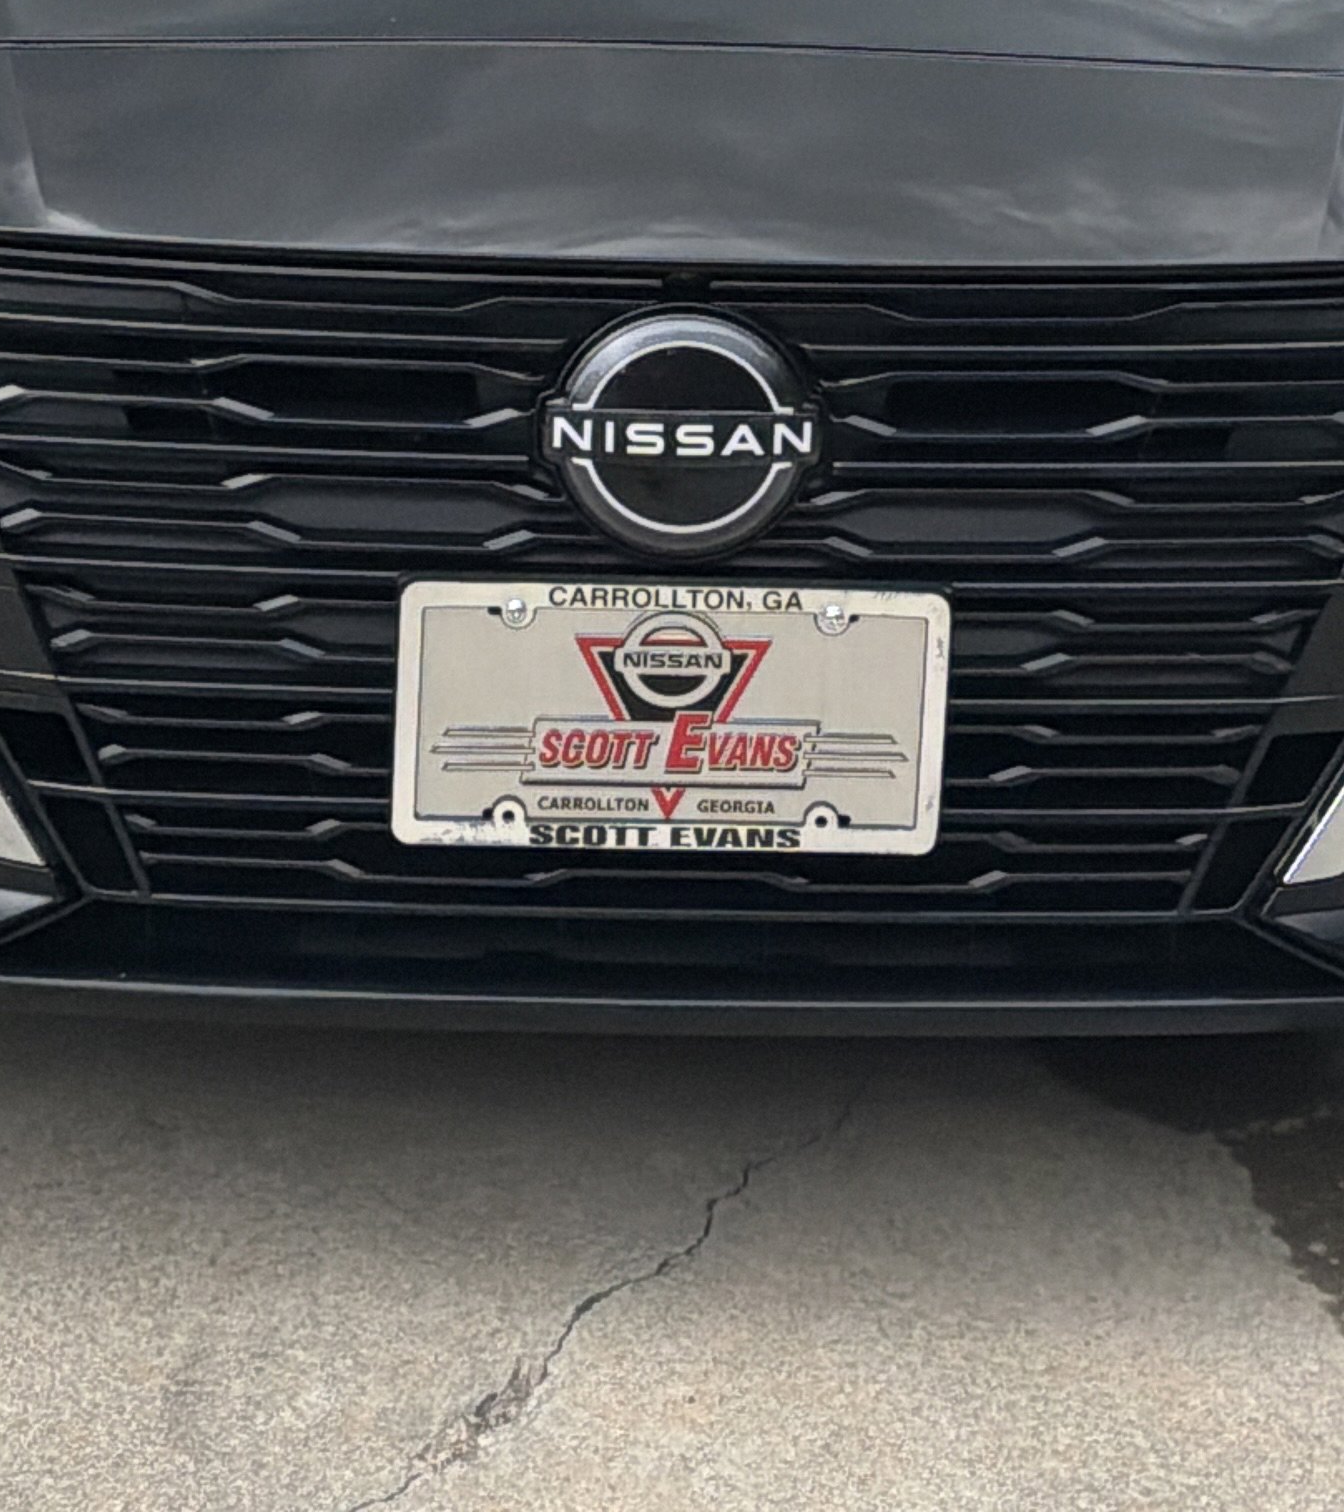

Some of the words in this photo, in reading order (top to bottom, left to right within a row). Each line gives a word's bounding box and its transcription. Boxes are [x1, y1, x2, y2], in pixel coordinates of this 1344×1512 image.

[552, 416, 813, 456] NISSAN
[548, 587, 752, 610] CARROLLTON,
[762, 590, 803, 611] GA
[623, 652, 723, 669] NISSAN
[538, 729, 657, 767] SCOTT
[665, 712, 799, 772] EVANS
[537, 796, 649, 811] CARROLLTON
[697, 799, 775, 814] GEORGIA
[529, 824, 657, 845] SCOTT
[670, 828, 801, 848] EVANS
